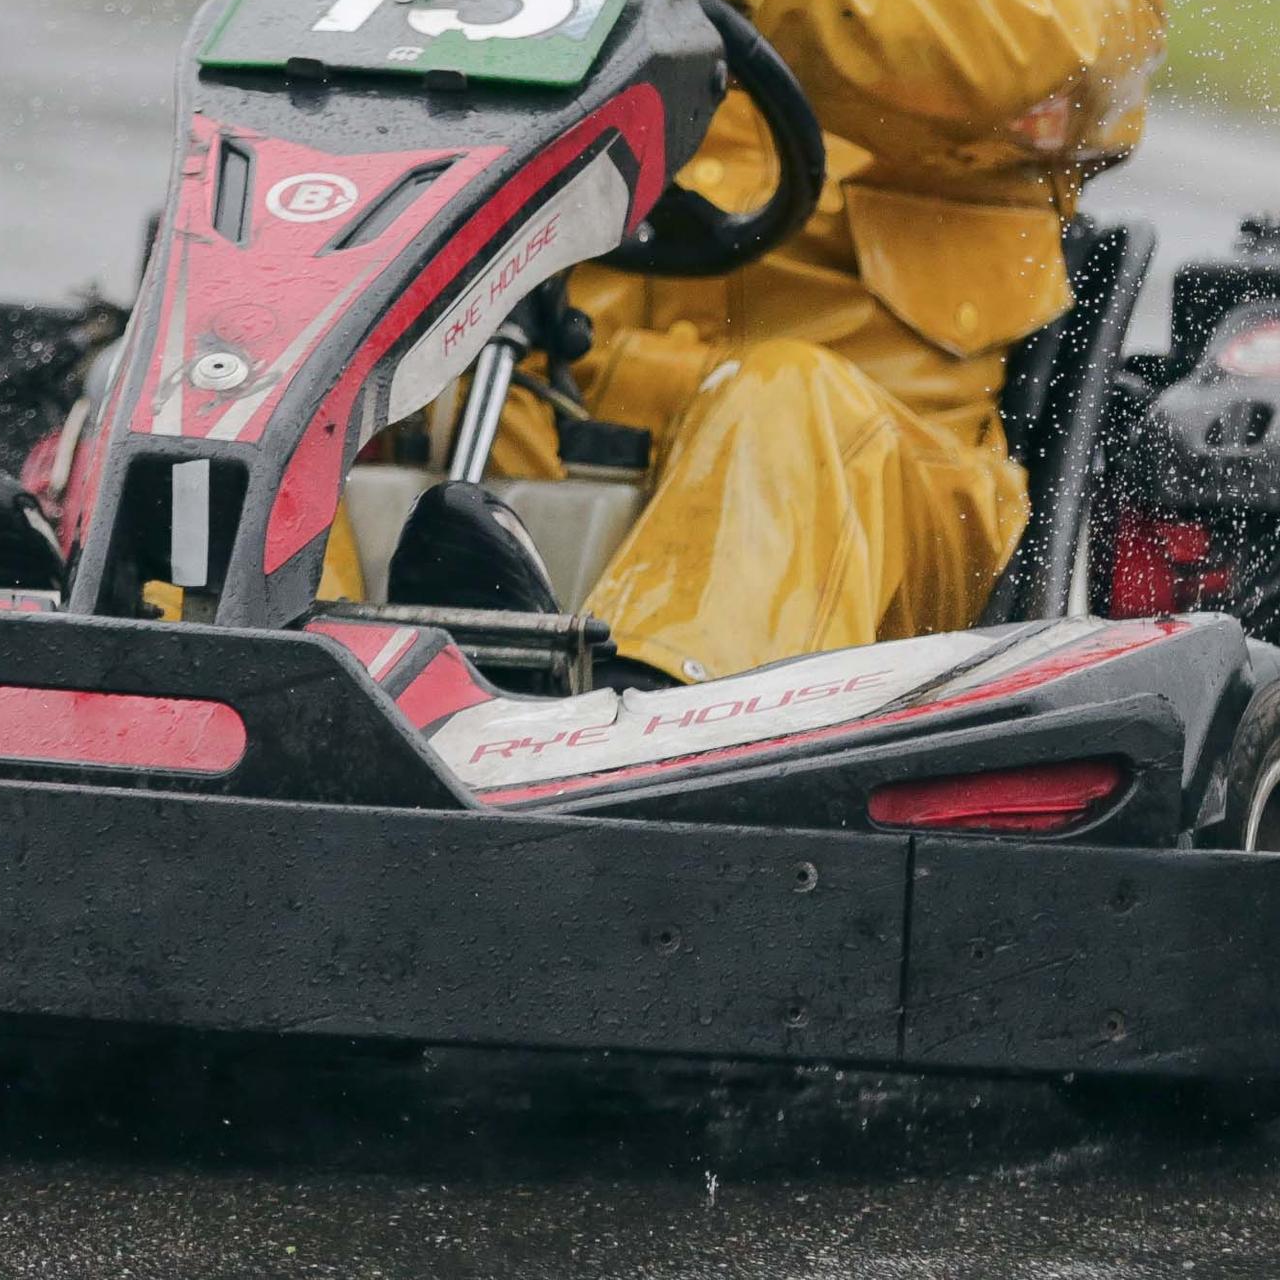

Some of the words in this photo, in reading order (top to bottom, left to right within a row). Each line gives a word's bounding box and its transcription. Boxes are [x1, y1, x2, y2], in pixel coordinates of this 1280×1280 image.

[442, 294, 483, 357] RYE
[489, 212, 561, 306] HOUSE
[469, 723, 614, 764] RYE
[643, 669, 893, 736] HOUSE
